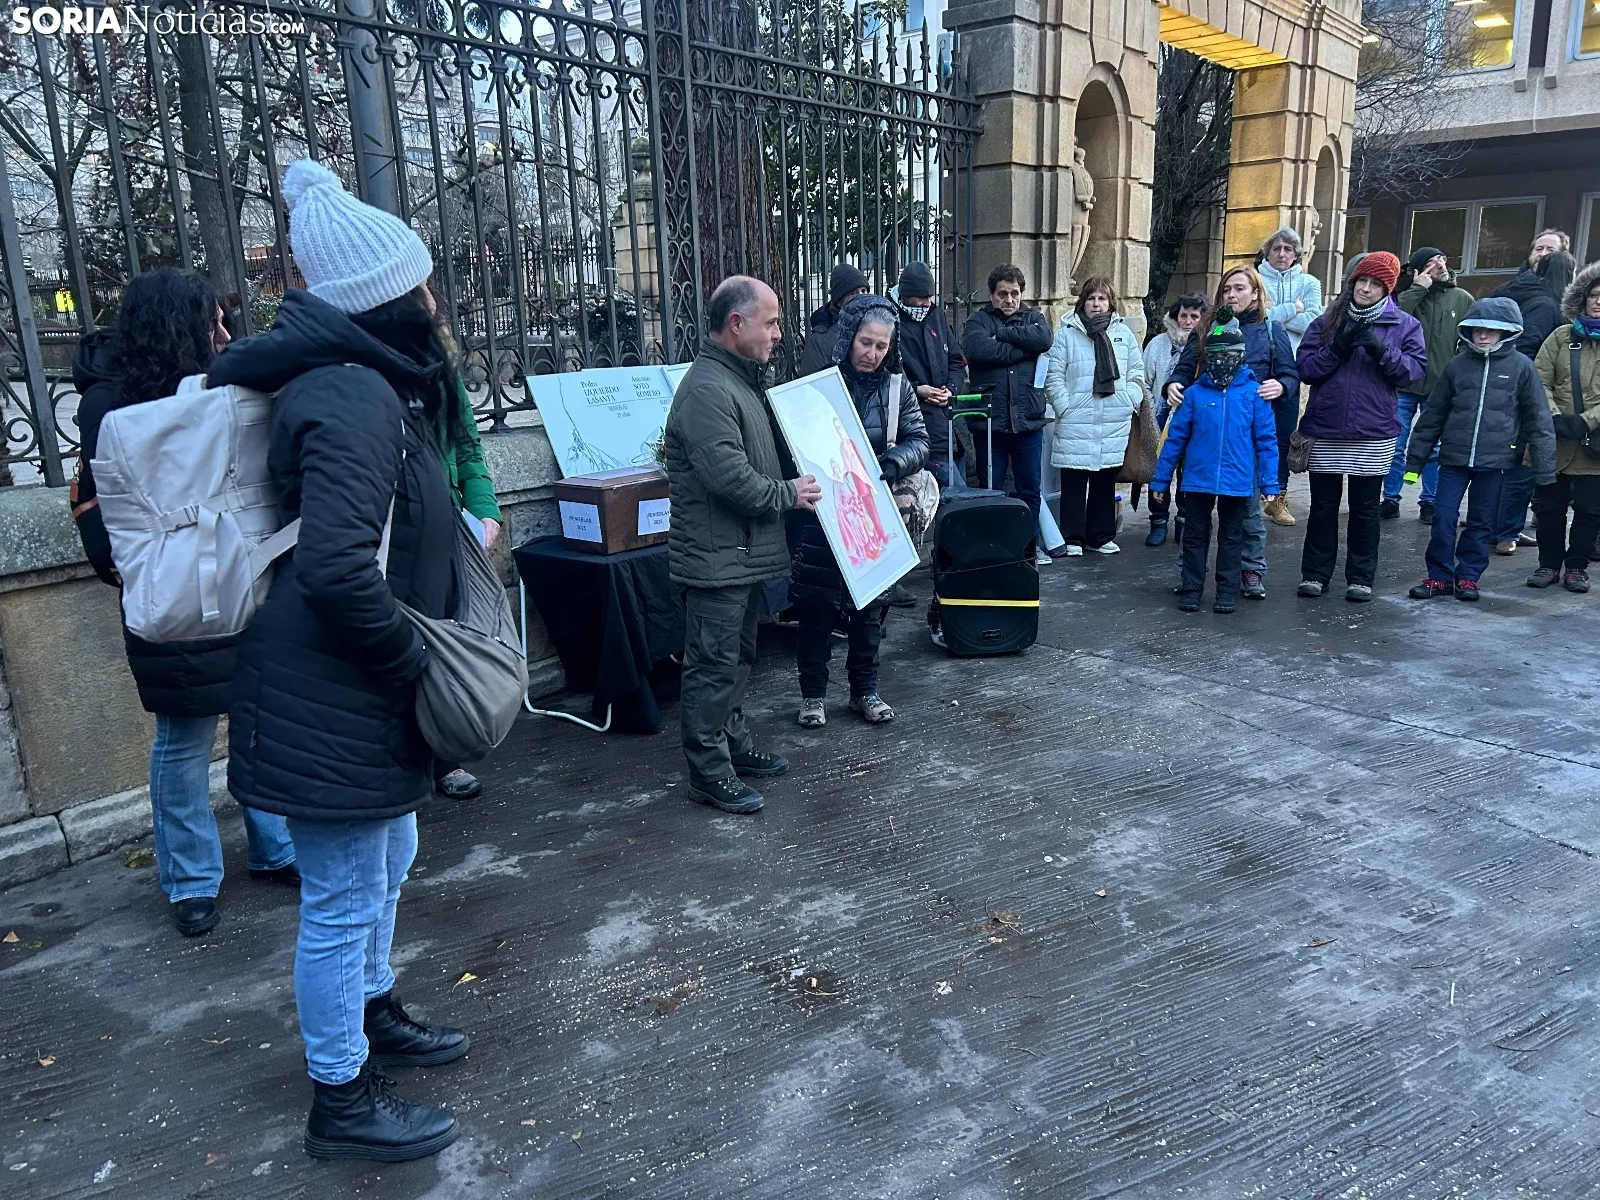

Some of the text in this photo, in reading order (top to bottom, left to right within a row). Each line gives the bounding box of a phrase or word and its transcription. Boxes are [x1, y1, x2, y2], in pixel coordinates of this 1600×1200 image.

[580, 380, 598, 389] Pedro
[632, 382, 650, 390] SOTO
[583, 386, 620, 397] IZQUIERDO
[635, 389, 661, 398] ROMERO
[586, 394, 616, 405] LASANTA
